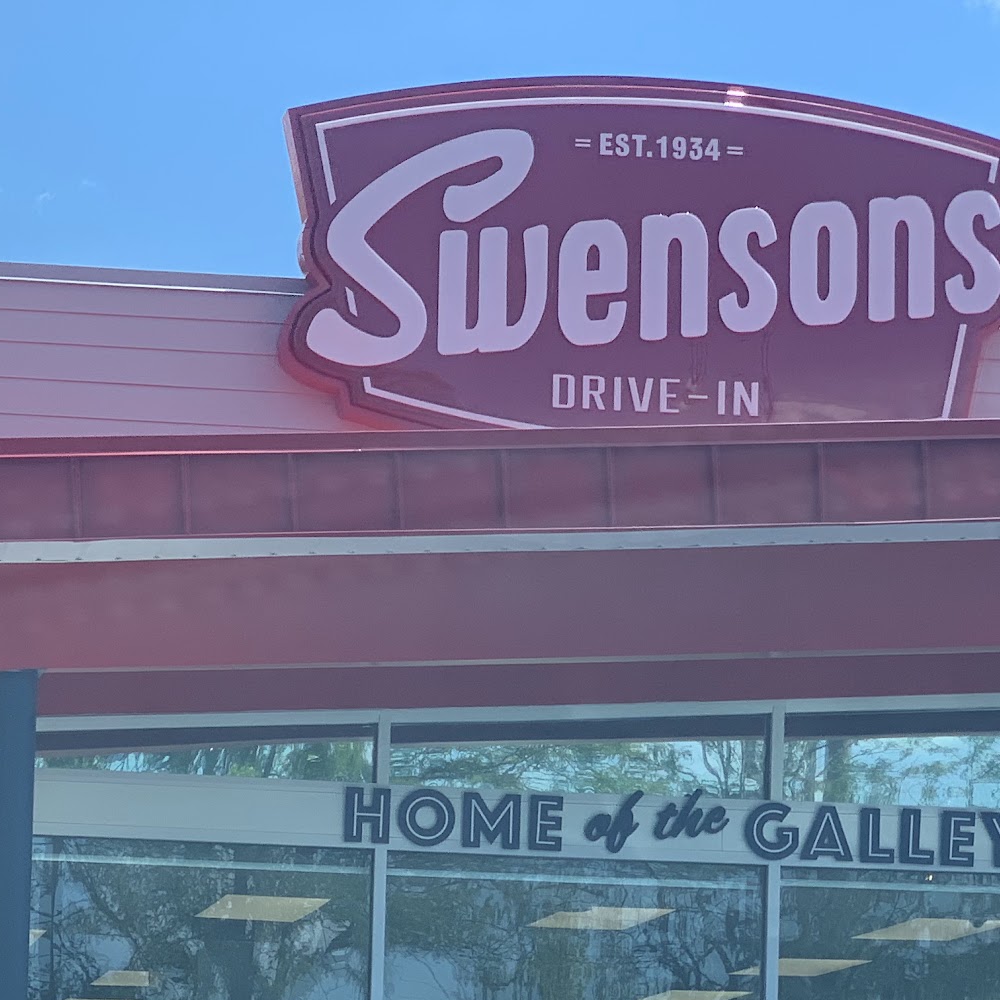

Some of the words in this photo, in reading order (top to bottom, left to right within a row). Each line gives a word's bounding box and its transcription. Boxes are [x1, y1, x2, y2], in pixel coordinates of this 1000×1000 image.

[305, 128, 1000, 367] Swensons
[343, 786, 565, 852] HOME
[583, 789, 645, 854] of
[653, 788, 730, 841] the
